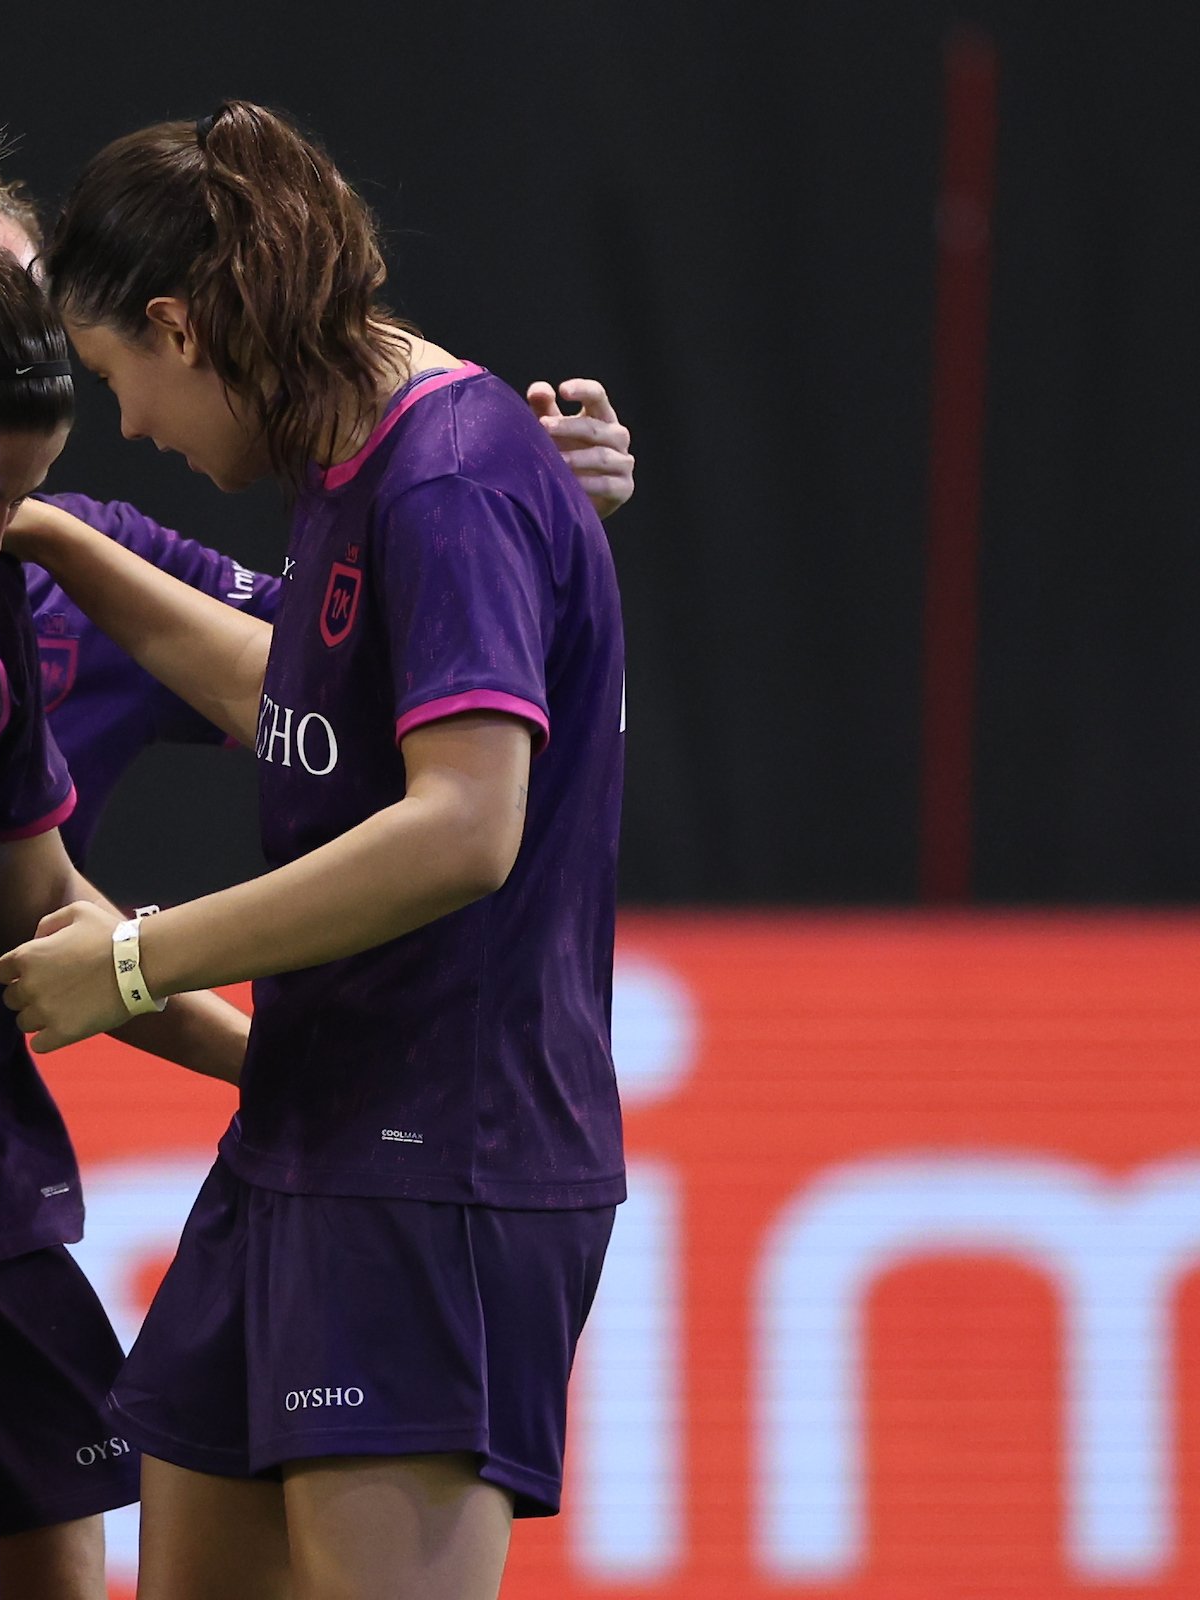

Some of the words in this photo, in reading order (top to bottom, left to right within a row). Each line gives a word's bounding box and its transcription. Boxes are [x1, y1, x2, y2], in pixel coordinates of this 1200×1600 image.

[255, 693, 338, 776] SHO
[285, 1386, 364, 1411] OYSHO
[76, 1437, 130, 1466] OYS
